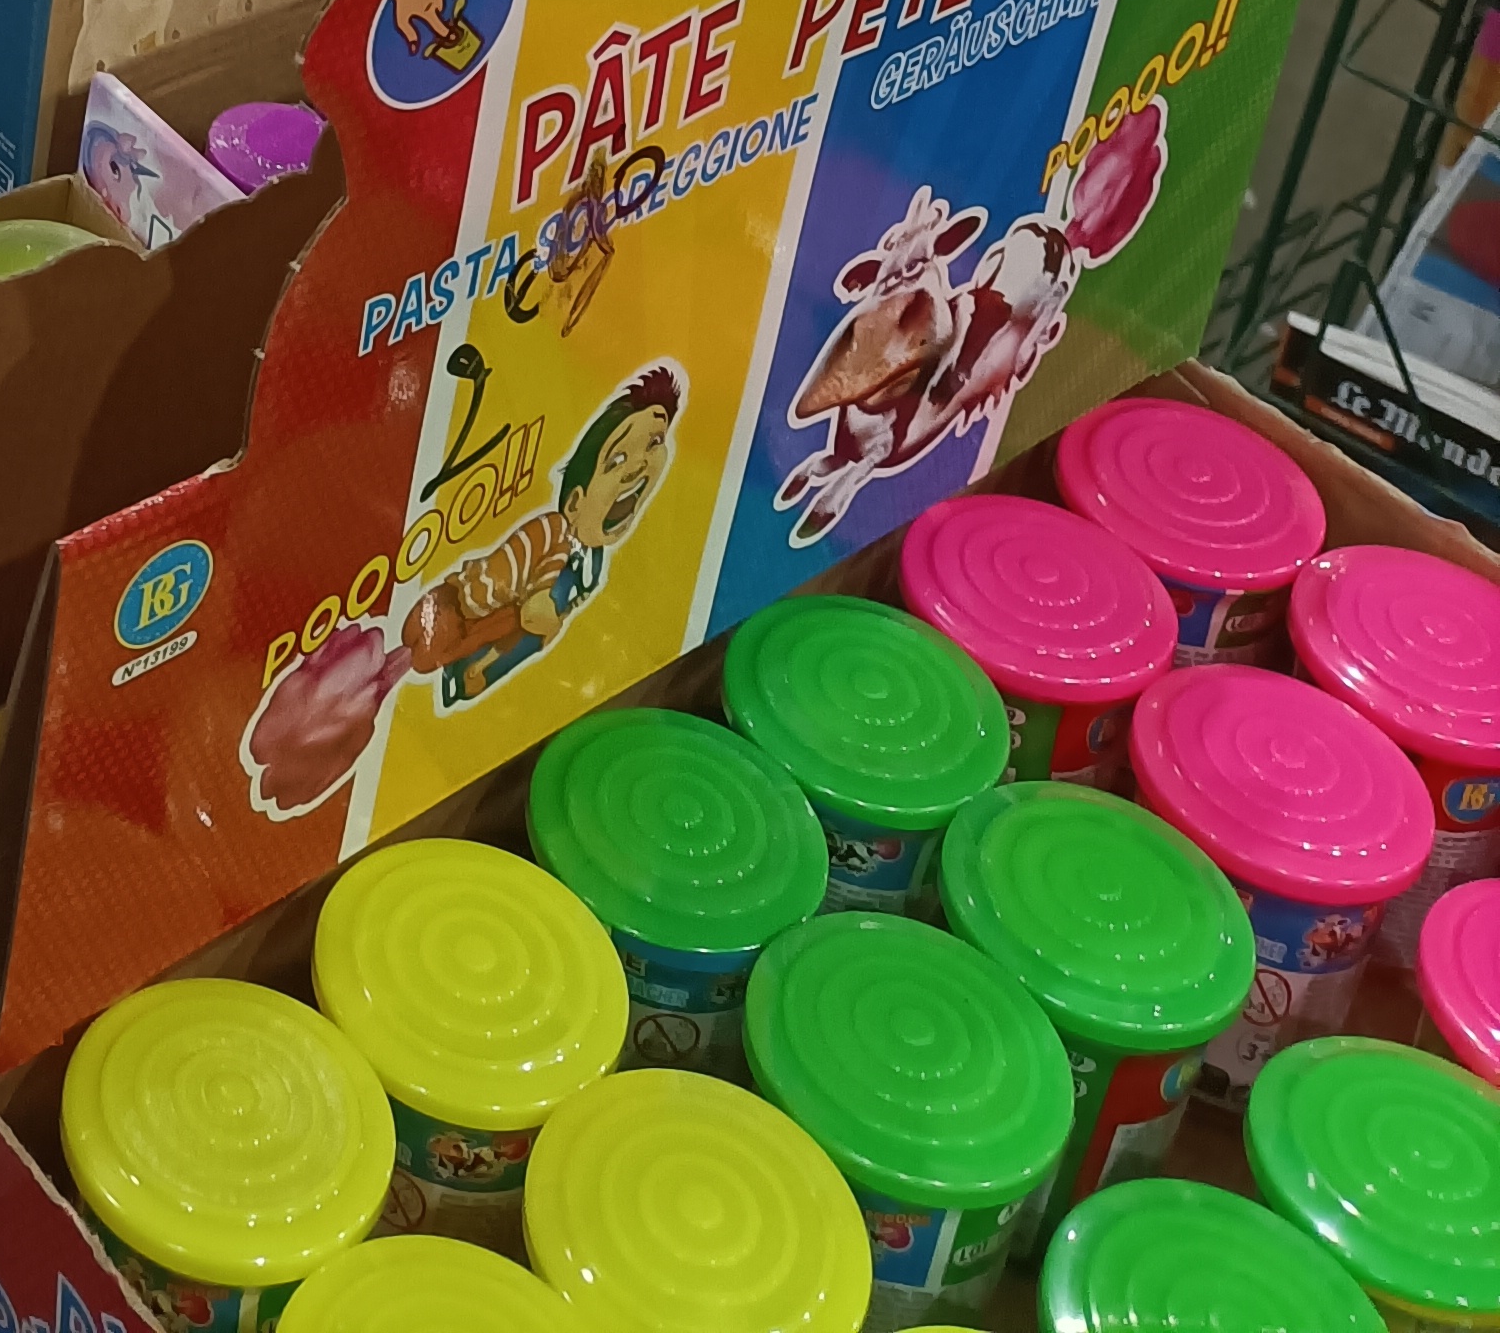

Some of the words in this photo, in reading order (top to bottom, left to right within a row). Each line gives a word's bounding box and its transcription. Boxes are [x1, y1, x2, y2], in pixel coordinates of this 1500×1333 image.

[359, 233, 519, 357] PASTA
[1330, 380, 1372, 417] Le
[120, 635, 190, 681] N°13199
